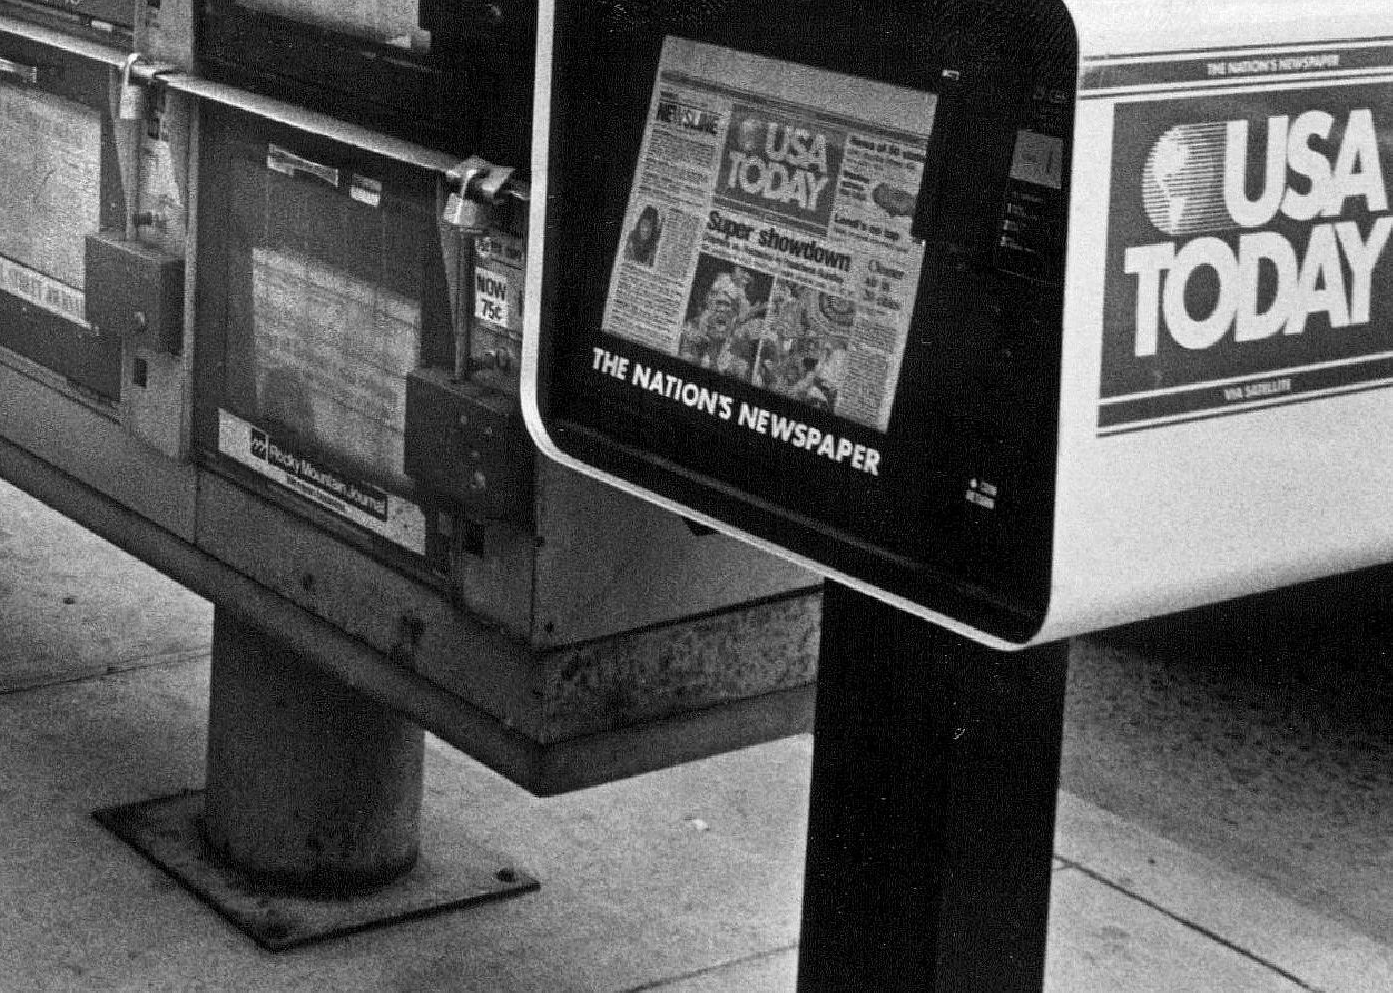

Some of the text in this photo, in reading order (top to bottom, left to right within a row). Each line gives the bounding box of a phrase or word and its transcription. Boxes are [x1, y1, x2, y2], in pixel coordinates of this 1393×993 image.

[765, 121, 827, 175] USA
[1223, 108, 1388, 229] USA
[727, 151, 829, 211] TODAY
[706, 210, 754, 240] Super
[757, 228, 851, 272] showdown
[476, 274, 506, 301] NOW
[1124, 216, 1393, 357] TODAY
[592, 347, 881, 477] THE NATION'S NEWSPAPER
